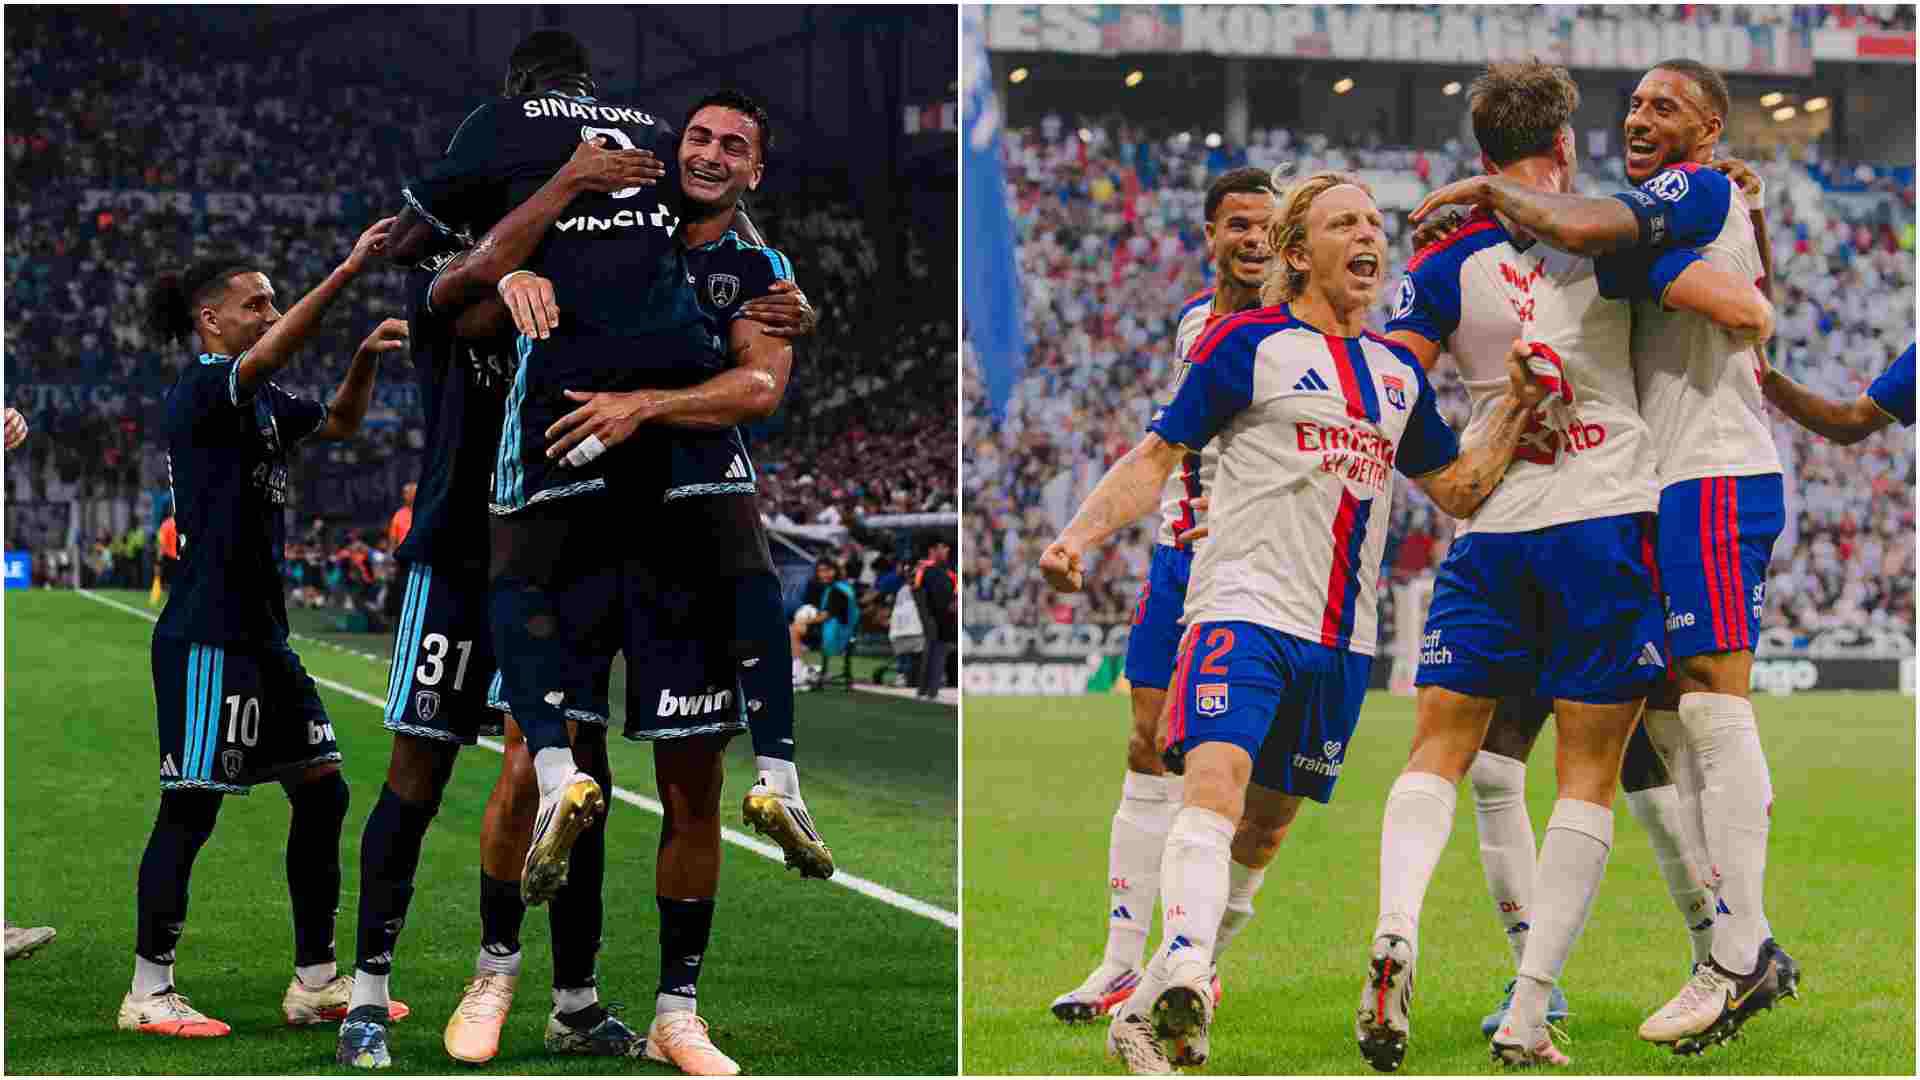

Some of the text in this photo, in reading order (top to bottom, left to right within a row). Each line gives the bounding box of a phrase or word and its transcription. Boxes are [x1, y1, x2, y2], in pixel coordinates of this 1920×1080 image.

[1183, 6, 1310, 56] KOP
[416, 632, 473, 692] 31
[1200, 628, 1236, 675] 2
[225, 694, 261, 747] 10
[656, 686, 733, 718] bwin
